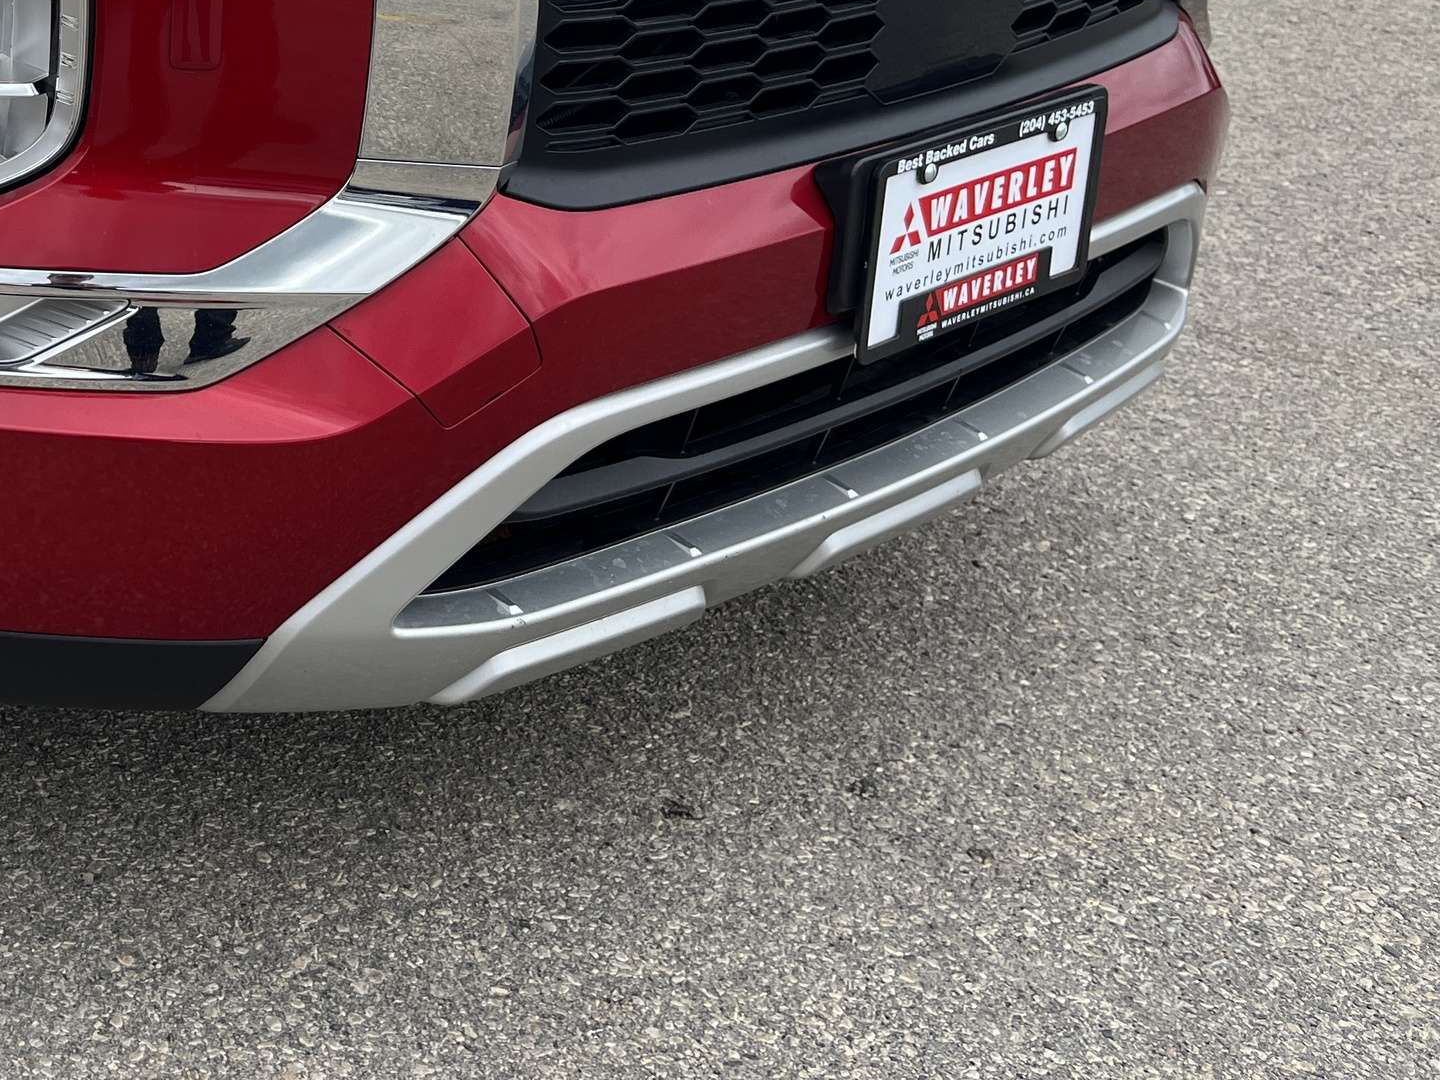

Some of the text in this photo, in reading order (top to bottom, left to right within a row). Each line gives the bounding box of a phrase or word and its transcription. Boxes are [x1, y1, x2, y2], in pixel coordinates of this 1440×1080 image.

[1018, 100, 1095, 138] (204) 453-5453
[897, 133, 995, 174] Best Backed Cars
[930, 153, 1075, 232] WAVERLEY
[927, 194, 1070, 263] MITSUBISHI
[884, 225, 1068, 302] waverleymitsubishi.com
[942, 256, 1038, 312] WAVERLEY
[941, 286, 1036, 329] WAVERLEYMITSUBISHI.CA
